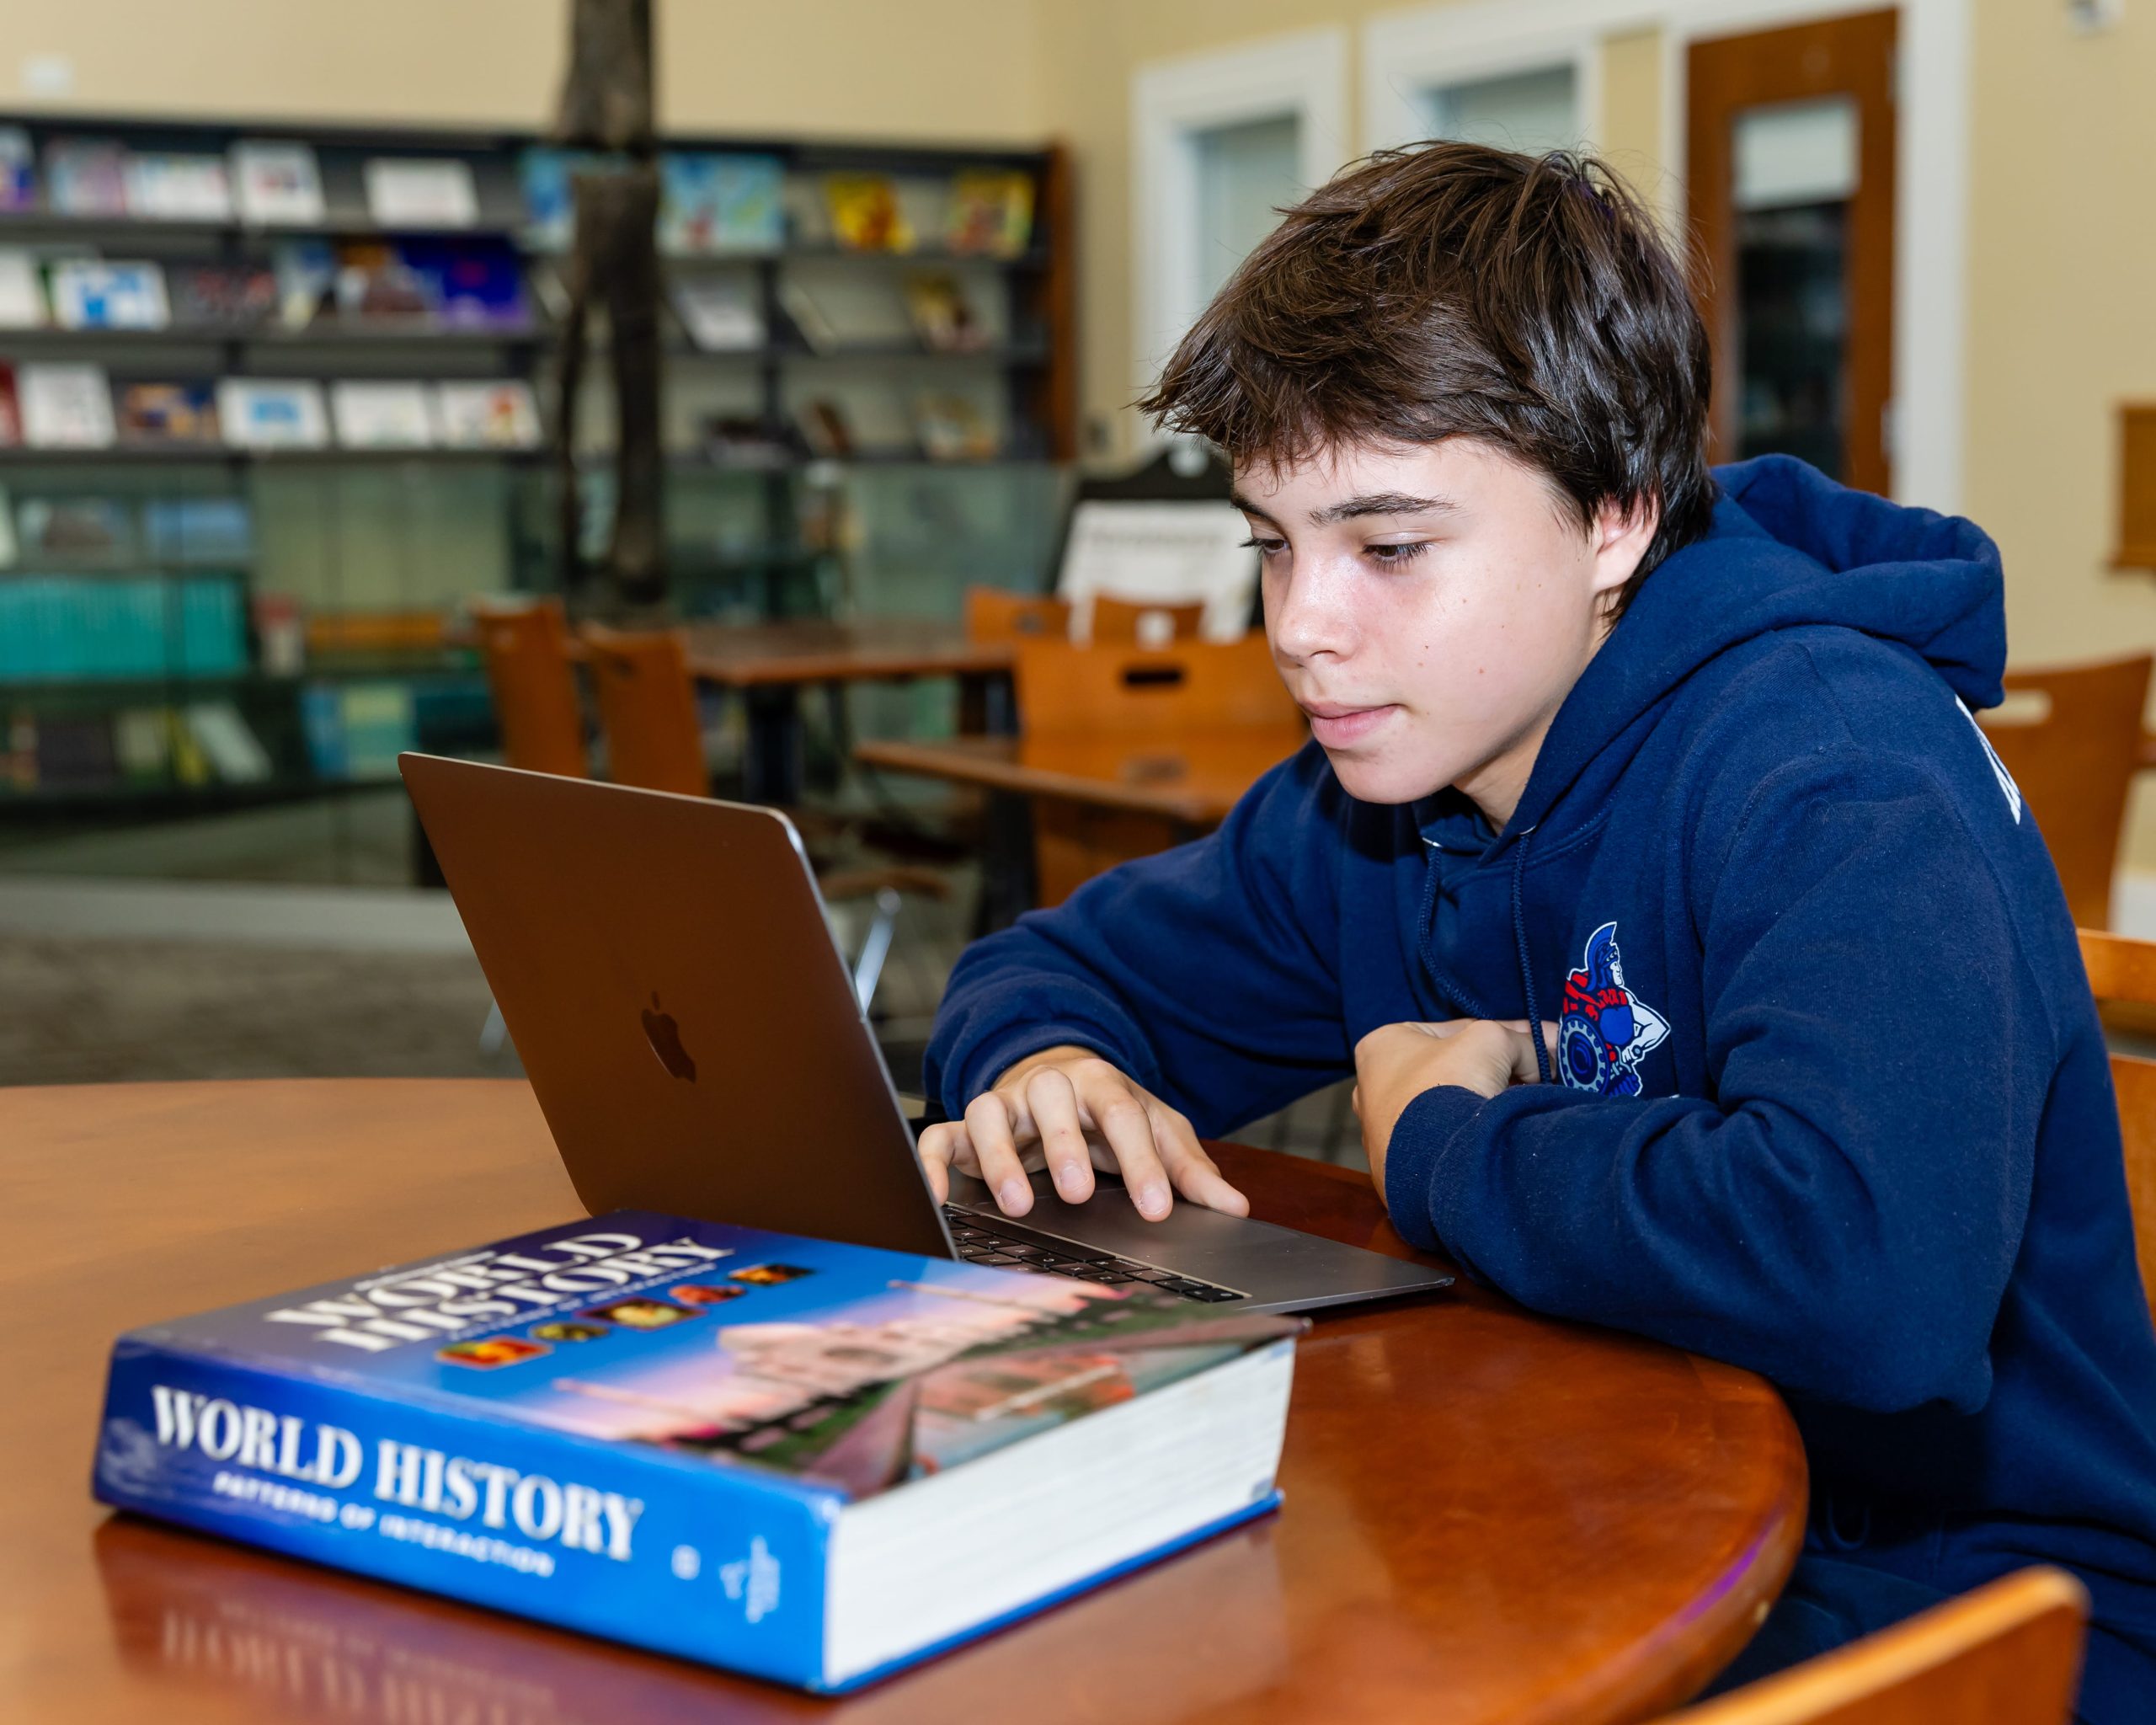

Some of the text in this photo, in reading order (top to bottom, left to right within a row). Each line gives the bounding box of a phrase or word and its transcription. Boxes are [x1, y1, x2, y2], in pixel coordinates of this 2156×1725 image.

[263, 1232, 643, 1327] WORLD
[312, 1236, 735, 1353] HISTORY
[151, 1384, 646, 1562] WORLD HISTORY
[339, 1503, 376, 1530] OF
